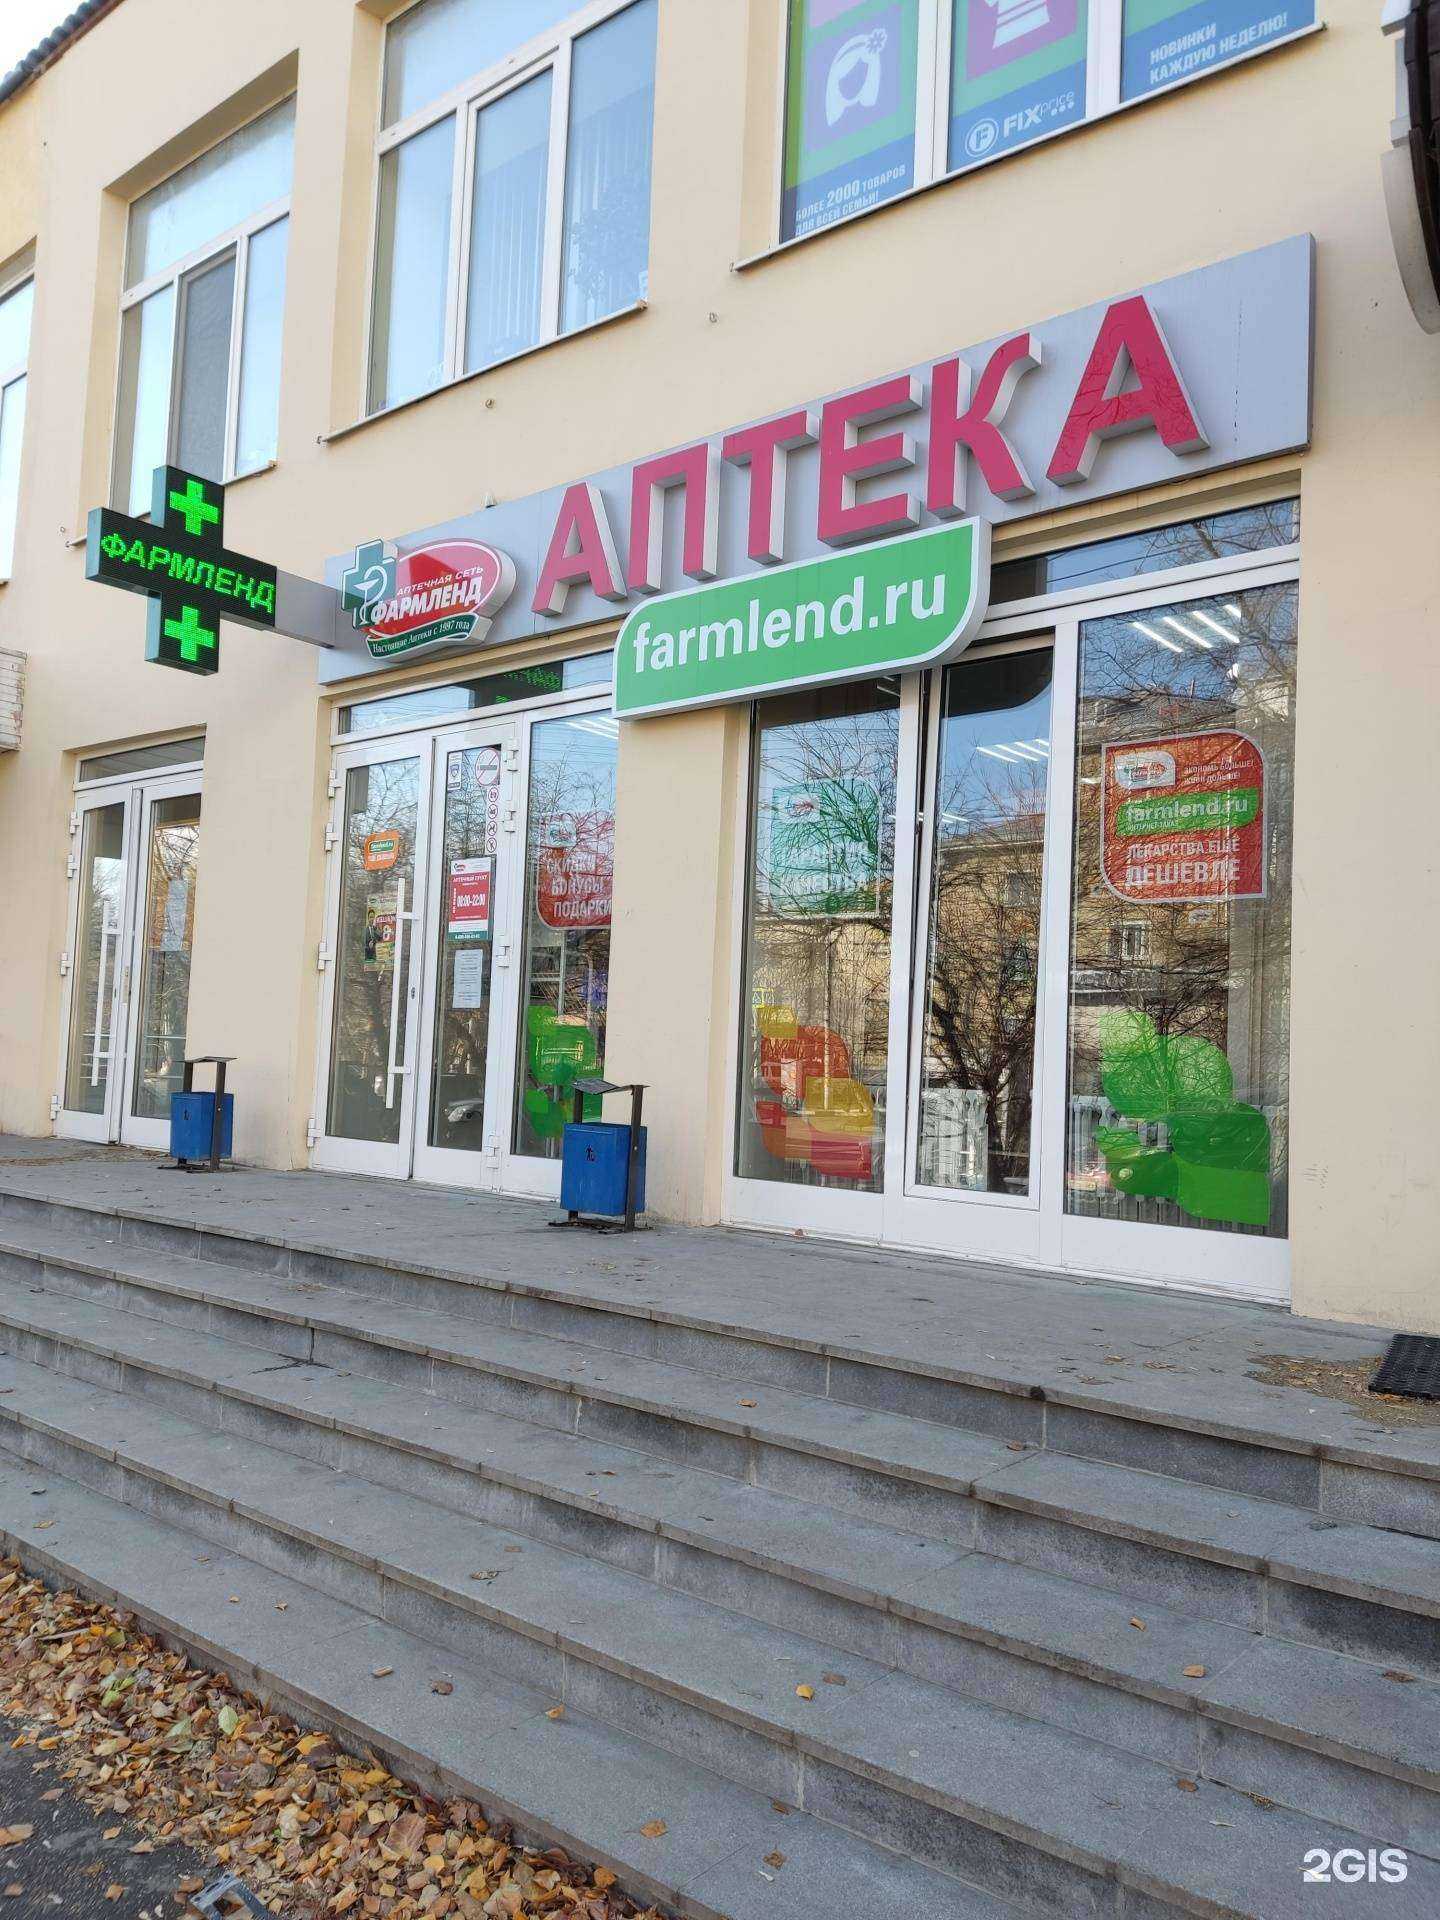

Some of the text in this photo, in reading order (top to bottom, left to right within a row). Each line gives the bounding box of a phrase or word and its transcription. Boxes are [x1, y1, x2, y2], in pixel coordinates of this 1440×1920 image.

[1151, 23, 1216, 64] НОВИНКИ
[1151, 12, 1288, 84] КАЖДУЮ НЕДЕЛЮ!
[795, 164, 906, 222] БОЛЕЕ 2000 ТОВАРОВ
[795, 221, 815, 237] ДЛЯ
[842, 190, 880, 216] СЕМЬИ!
[531, 294, 1210, 616] АПТЕКА
[101, 533, 277, 614] ФАРМЛЕНД
[397, 566, 484, 596] АПТЕЧНАЯ СЕТЬ
[371, 575, 483, 625] ФАРМЛЕНД
[632, 571, 946, 674] farmlend.ru
[408, 629, 432, 645] Аптеки
[1126, 799, 1248, 822] farmlend.ru
[1125, 858, 1241, 887] ДЕШЕВЛЕ
[1128, 840, 1205, 861] ЛЕКАРСТВА
